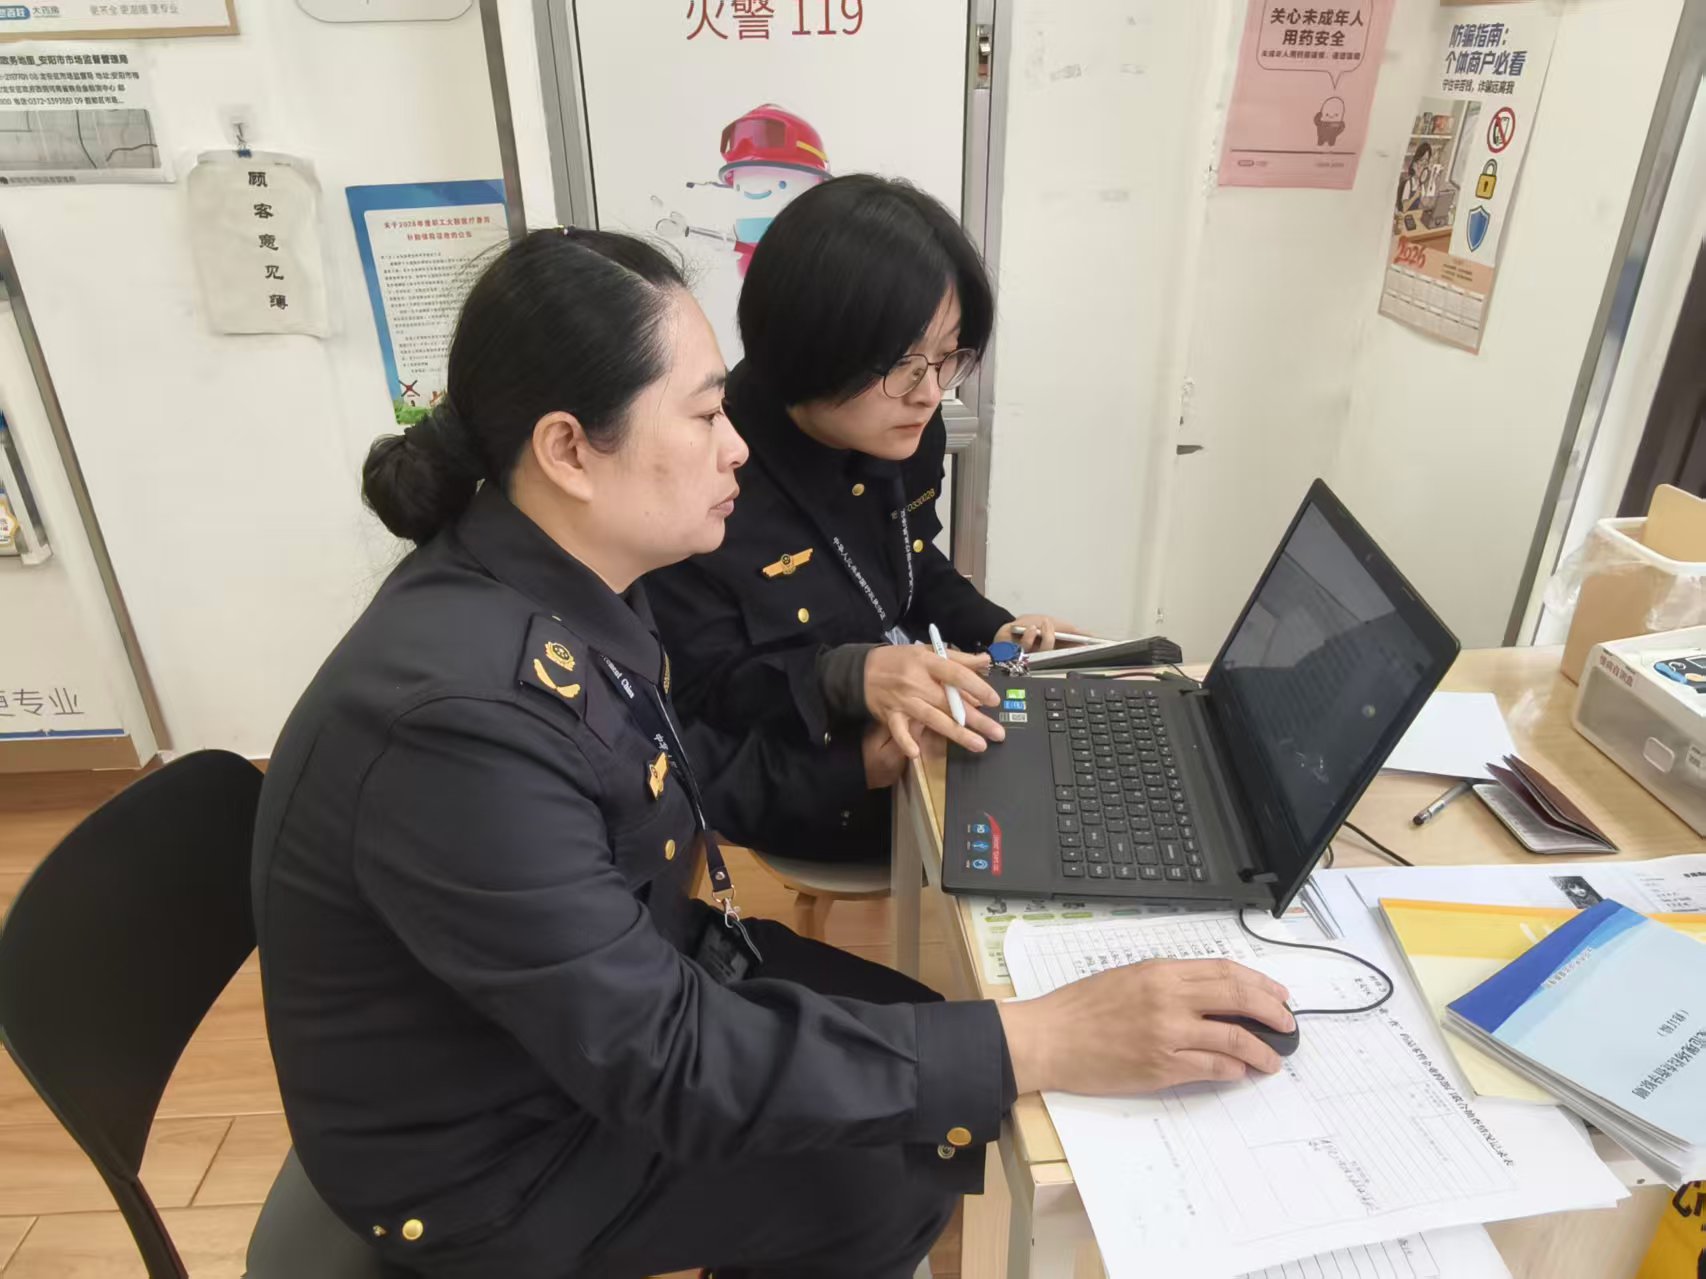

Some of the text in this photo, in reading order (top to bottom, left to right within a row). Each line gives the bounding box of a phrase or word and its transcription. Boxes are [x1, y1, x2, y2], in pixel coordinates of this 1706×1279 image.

[686, 0, 864, 41] 火警 119
[1270, 7, 1364, 27] 关心未成年人
[1281, 29, 1345, 47] 用药安全
[1448, 23, 1509, 48] 防骗指南:
[1445, 50, 1528, 76] 个体商户必看
[247, 171, 289, 310] 顾客意见簿
